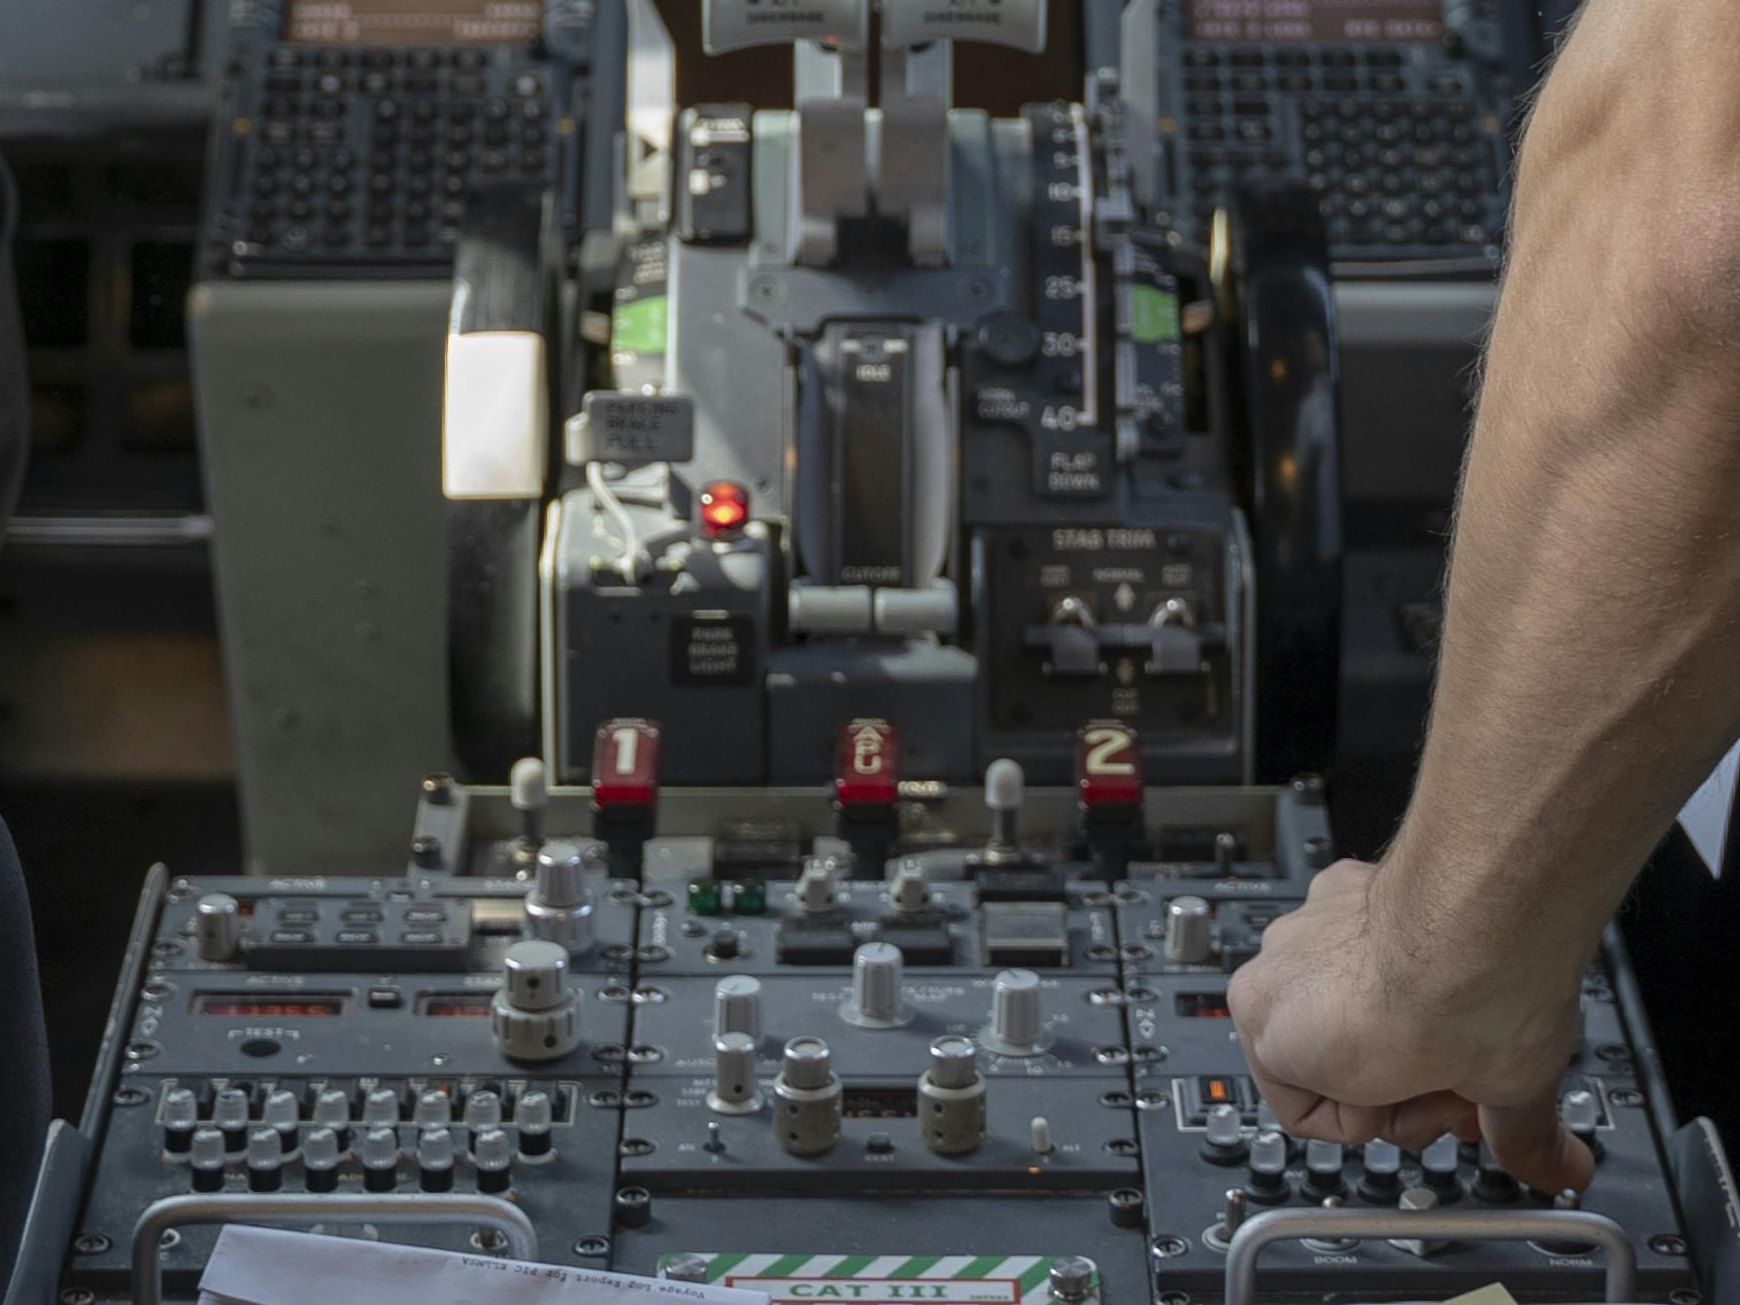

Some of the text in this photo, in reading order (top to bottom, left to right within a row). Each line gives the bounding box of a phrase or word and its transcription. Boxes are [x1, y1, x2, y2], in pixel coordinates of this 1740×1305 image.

[1045, 275, 1075, 300] 25
[1041, 331, 1076, 357] 30
[856, 363, 892, 383] IDLE
[607, 416, 661, 431] BRAKE
[1041, 405, 1077, 431] 40
[1050, 453, 1097, 471] FLAP
[1048, 471, 1100, 490] DOWN
[1052, 528, 1156, 551] STAB TRIM
[691, 626, 734, 642] PARK
[689, 643, 739, 659] BRAKE
[689, 659, 737, 675] LIGHT
[611, 727, 638, 775] 1
[1083, 728, 1137, 776] 2
[245, 975, 305, 987] ACTIVE
[245, 1027, 284, 1039] TEST
[1314, 1255, 1358, 1265] BOOM
[1548, 1257, 1594, 1268] NORM
[513, 1263, 706, 1300] Voyage Log Report for PIC
[789, 1283, 948, 1299] CAT III
